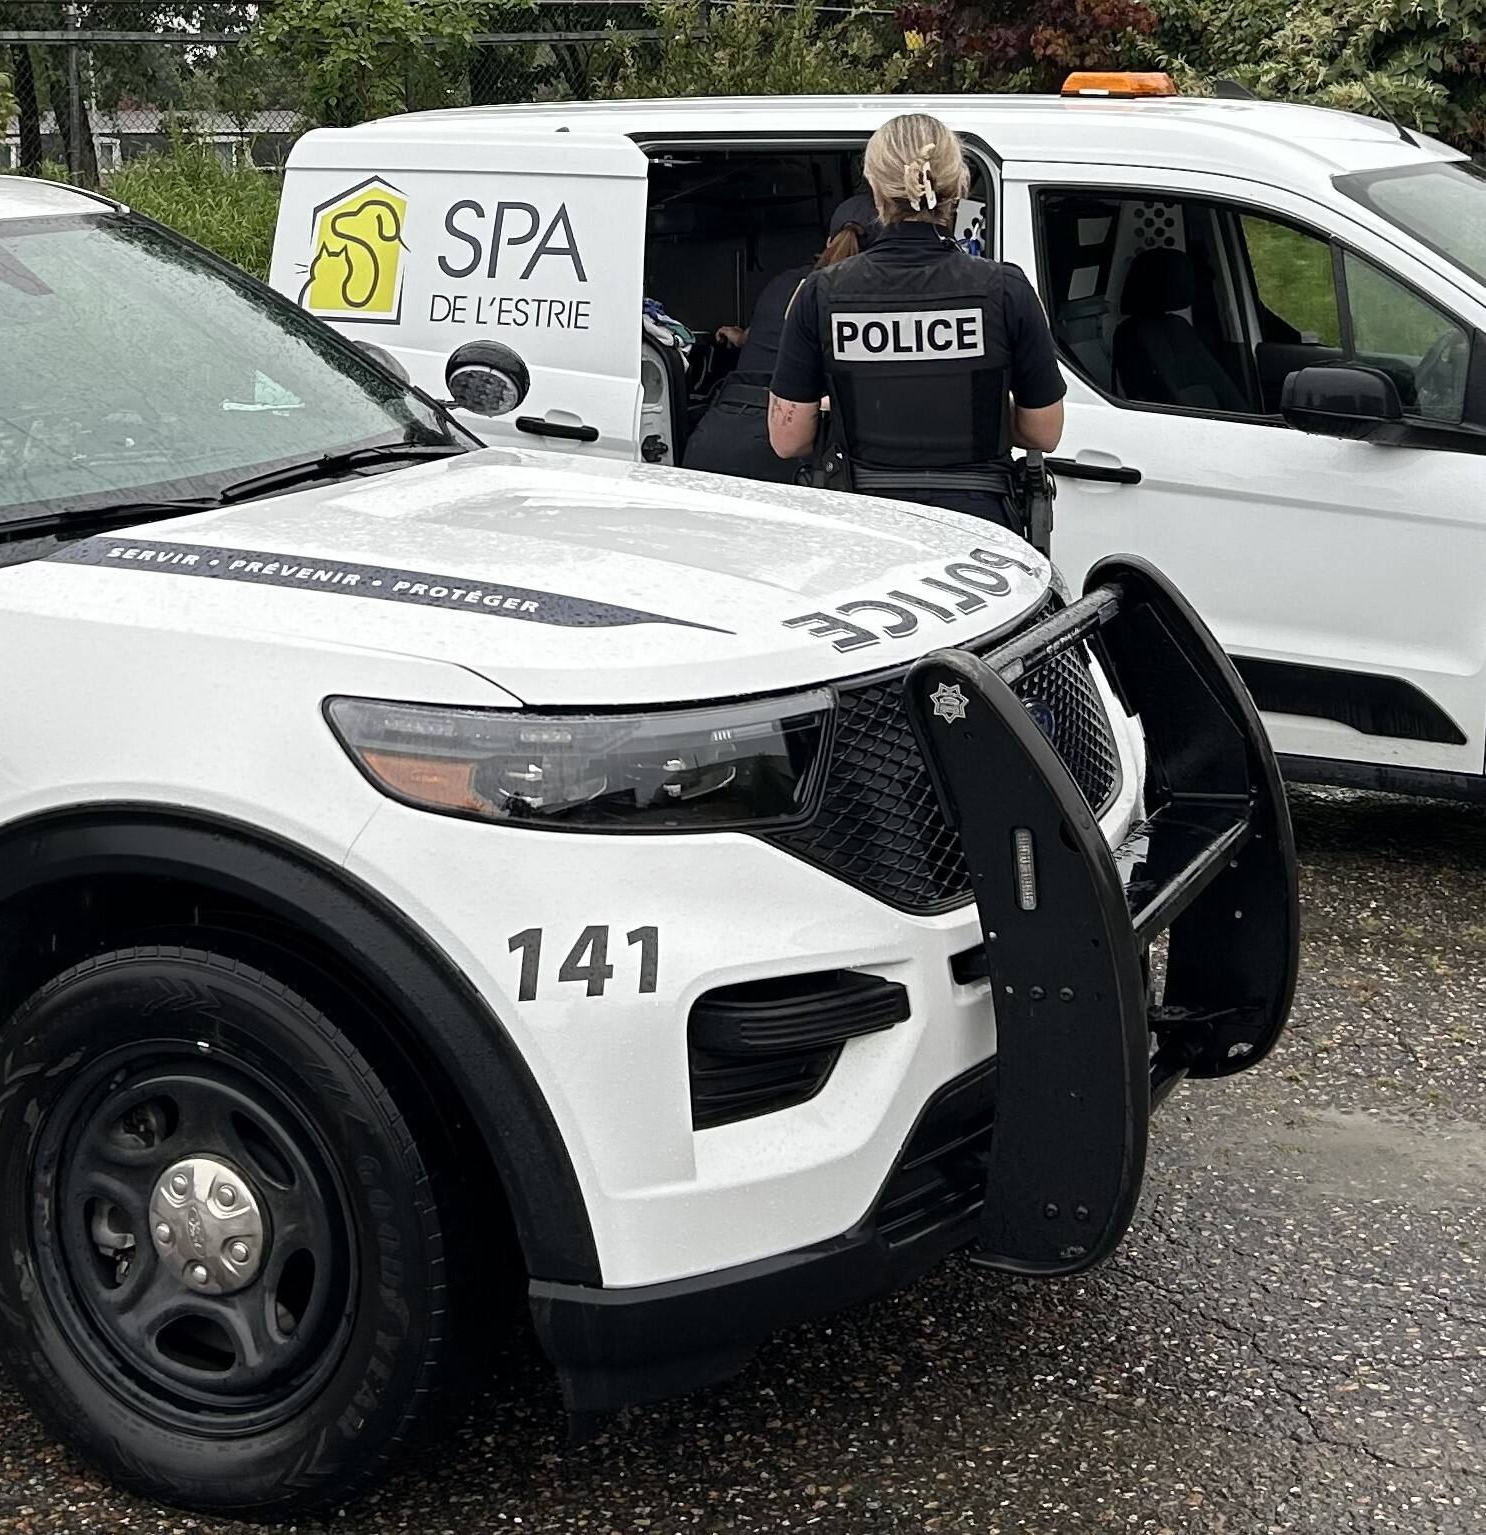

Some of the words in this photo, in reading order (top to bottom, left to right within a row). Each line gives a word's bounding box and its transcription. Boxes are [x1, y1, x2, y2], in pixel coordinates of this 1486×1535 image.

[437, 199, 588, 282] SPA
[429, 294, 468, 323] DE
[475, 296, 591, 330] L'ESTRIE
[836, 316, 979, 354] POLICE
[106, 546, 200, 566] SERVIR
[228, 558, 362, 586] PRÉVENIR
[392, 579, 541, 614] PROTÉGER
[507, 924, 659, 1002] 141
